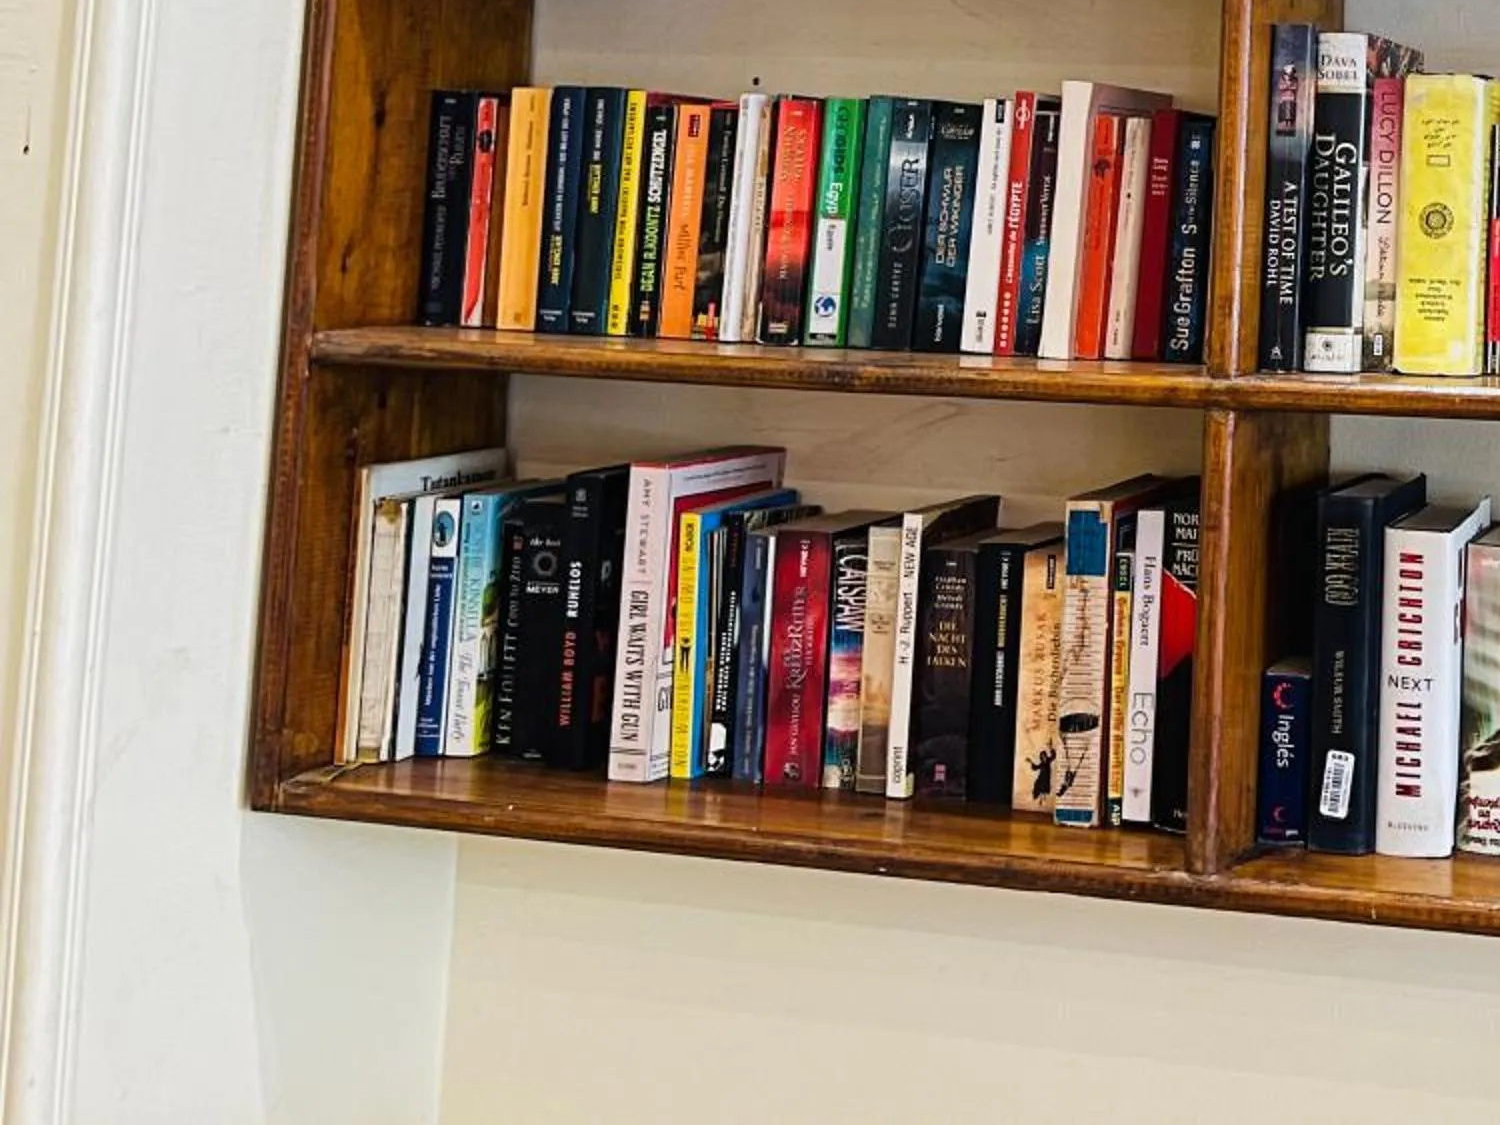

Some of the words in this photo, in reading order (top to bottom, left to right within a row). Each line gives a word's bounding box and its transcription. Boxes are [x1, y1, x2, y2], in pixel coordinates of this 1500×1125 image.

[1318, 70, 1358, 81] SOBEL
[1319, 54, 1357, 68] DAVA
[1379, 90, 1397, 143] LUCY
[648, 129, 667, 203] SCHUTZENGEL
[1185, 161, 1201, 205] Silence
[826, 182, 843, 215] Egyp
[937, 167, 952, 232] SCHWUR
[949, 165, 964, 234] WIKINGER
[1285, 180, 1296, 192] A
[1376, 149, 1393, 224] DILLON
[1269, 200, 1281, 242] DAVID
[1283, 197, 1296, 233] TEST
[1309, 134, 1334, 283] DAUGHTER
[1331, 143, 1357, 276] GALILEO'S
[936, 235, 947, 263] DER
[946, 237, 957, 267] DER
[1267, 247, 1279, 286] ROHL
[1282, 237, 1295, 259] OF
[642, 263, 656, 291] DEAN
[1173, 247, 1196, 314] Grafton
[1280, 262, 1293, 304] TIME
[1028, 297, 1041, 323] Lisa
[1171, 318, 1189, 350] Sue
[642, 479, 652, 505] AMY
[638, 514, 650, 574] STEWART
[905, 527, 917, 548] AGE
[1326, 527, 1358, 570] RIVER
[904, 552, 915, 579] NEW
[1144, 556, 1156, 589] Hans
[566, 561, 582, 617] RUHELOS
[630, 590, 648, 619] GIRL
[835, 554, 867, 632] CATSPAW
[1325, 575, 1358, 605] GOD
[901, 593, 914, 634] Ruppert
[939, 621, 957, 630] DIE
[1140, 594, 1154, 645] Bogaert
[1398, 553, 1423, 666] CRICHTON
[563, 632, 576, 666] BOYD
[626, 623, 646, 665] WAITS
[928, 632, 966, 643] NACHT
[936, 646, 957, 655] DES
[1034, 613, 1046, 661] ZUSAK
[496, 634, 517, 703] FOLLETT
[927, 657, 966, 667] FALKEN
[1048, 623, 1061, 698] Bücherdiebin
[1333, 650, 1345, 694] WILBUR
[560, 672, 573, 726] WILLIAM
[623, 670, 642, 708] WITH
[1031, 668, 1044, 731] MARKUS
[1387, 675, 1435, 691] NEXT
[495, 710, 512, 744] KEN
[621, 713, 640, 741] GUN
[1047, 705, 1056, 722] Die
[1132, 693, 1153, 765] Echo
[1332, 697, 1343, 733] SMITH
[1273, 714, 1295, 767] Inglés
[1396, 702, 1421, 797] MICHAEL
[891, 747, 903, 784] coprint
